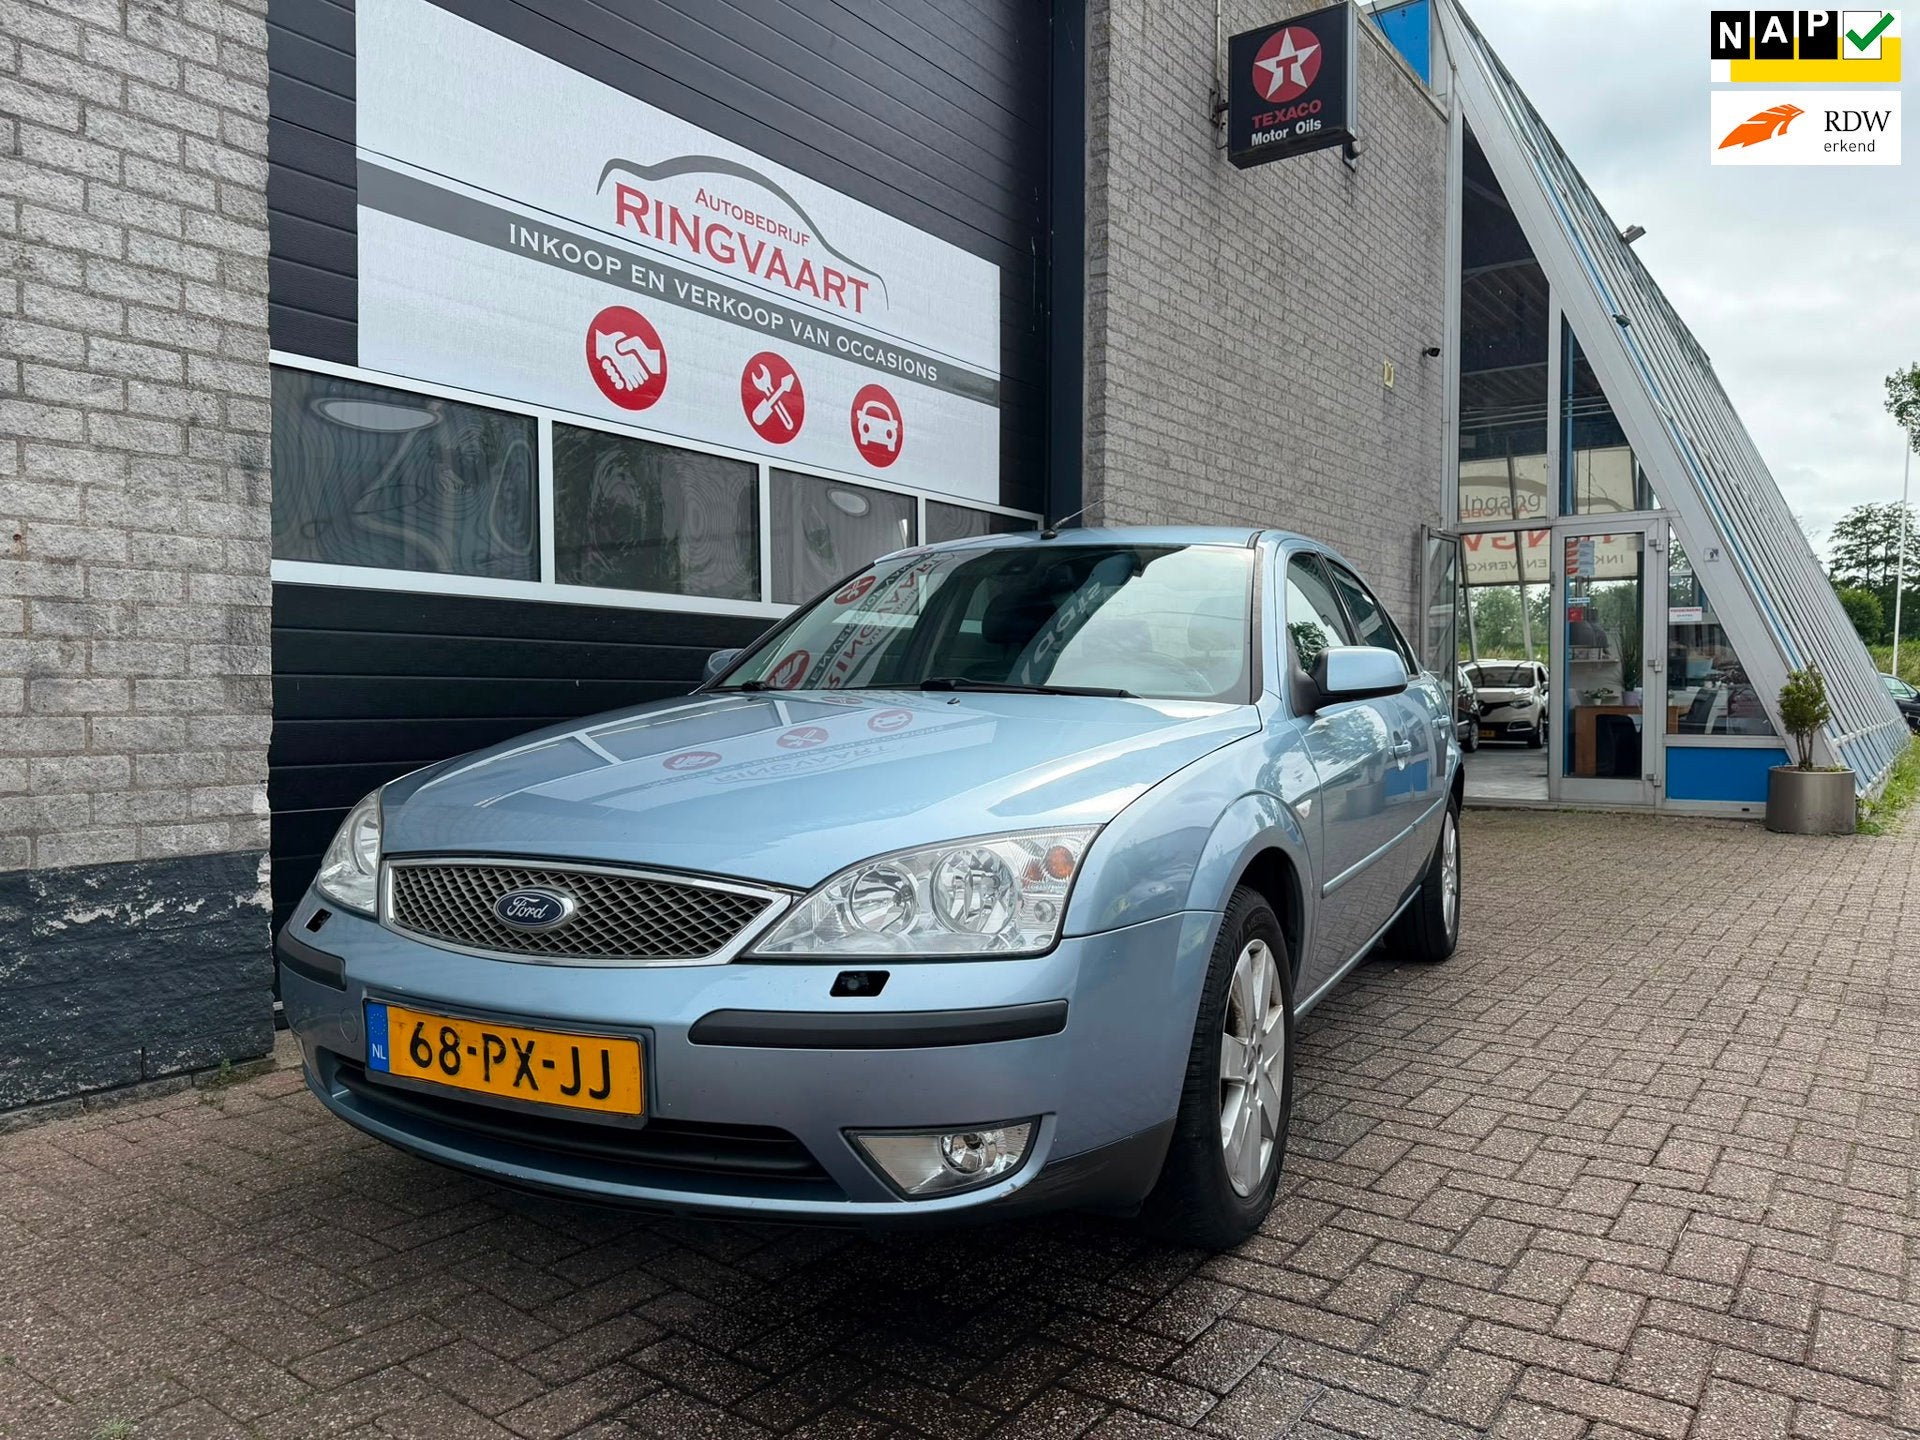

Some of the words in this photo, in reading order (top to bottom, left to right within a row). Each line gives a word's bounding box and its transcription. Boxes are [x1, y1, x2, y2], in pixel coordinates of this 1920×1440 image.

[1251, 100, 1322, 129] TEXACO
[1251, 127, 1289, 147] Motor
[1295, 118, 1322, 135] Oils
[694, 187, 811, 248] AUTOBEDRIJF
[614, 181, 869, 314] RINGVAART
[508, 222, 622, 275] INKOOP
[631, 265, 665, 293] EN
[674, 280, 784, 332] VERKOOP
[790, 317, 831, 349] VAN
[836, 334, 939, 382] OCCASIONS
[1465, 493, 1541, 516] Ingang
[506, 896, 549, 919] Ford
[372, 1043, 387, 1061] NL
[409, 1021, 612, 1101] 68-PX-JJ
